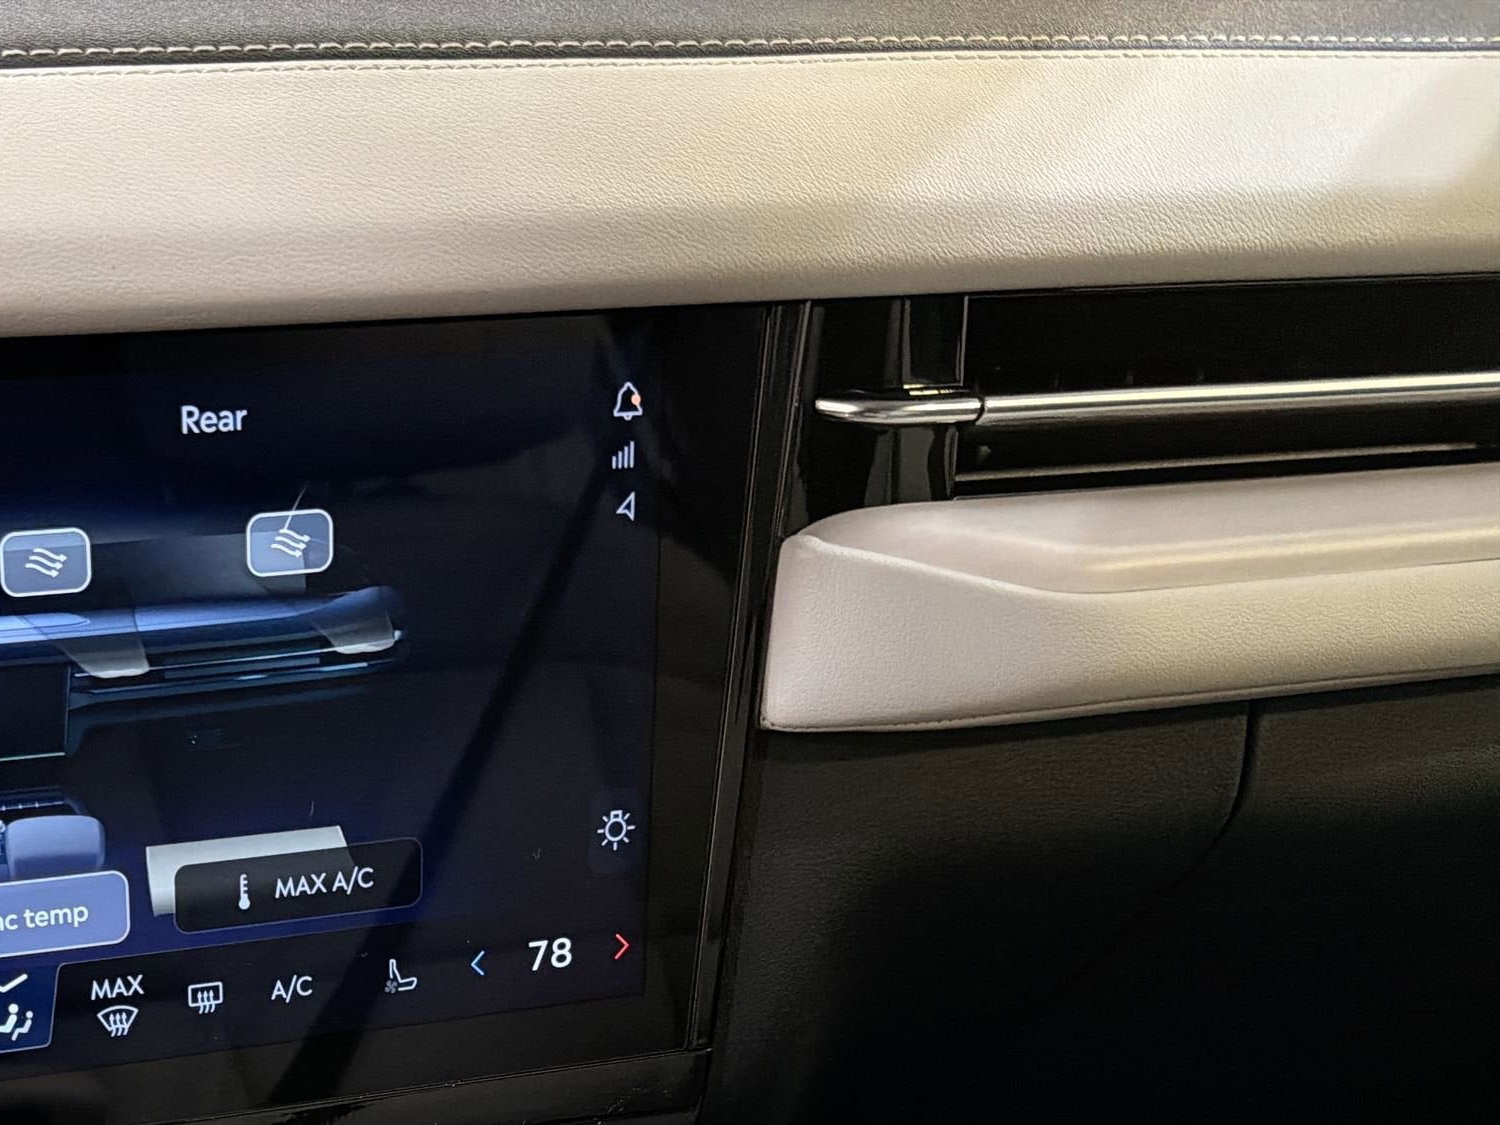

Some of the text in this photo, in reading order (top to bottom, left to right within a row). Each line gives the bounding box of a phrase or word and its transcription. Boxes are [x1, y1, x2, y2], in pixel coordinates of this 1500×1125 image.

[180, 404, 247, 434] Rear
[275, 867, 374, 899] MAX A/C
[24, 902, 90, 933] temp
[528, 938, 573, 972] 78
[91, 975, 145, 1000] MAX
[271, 976, 313, 1002] A/C
